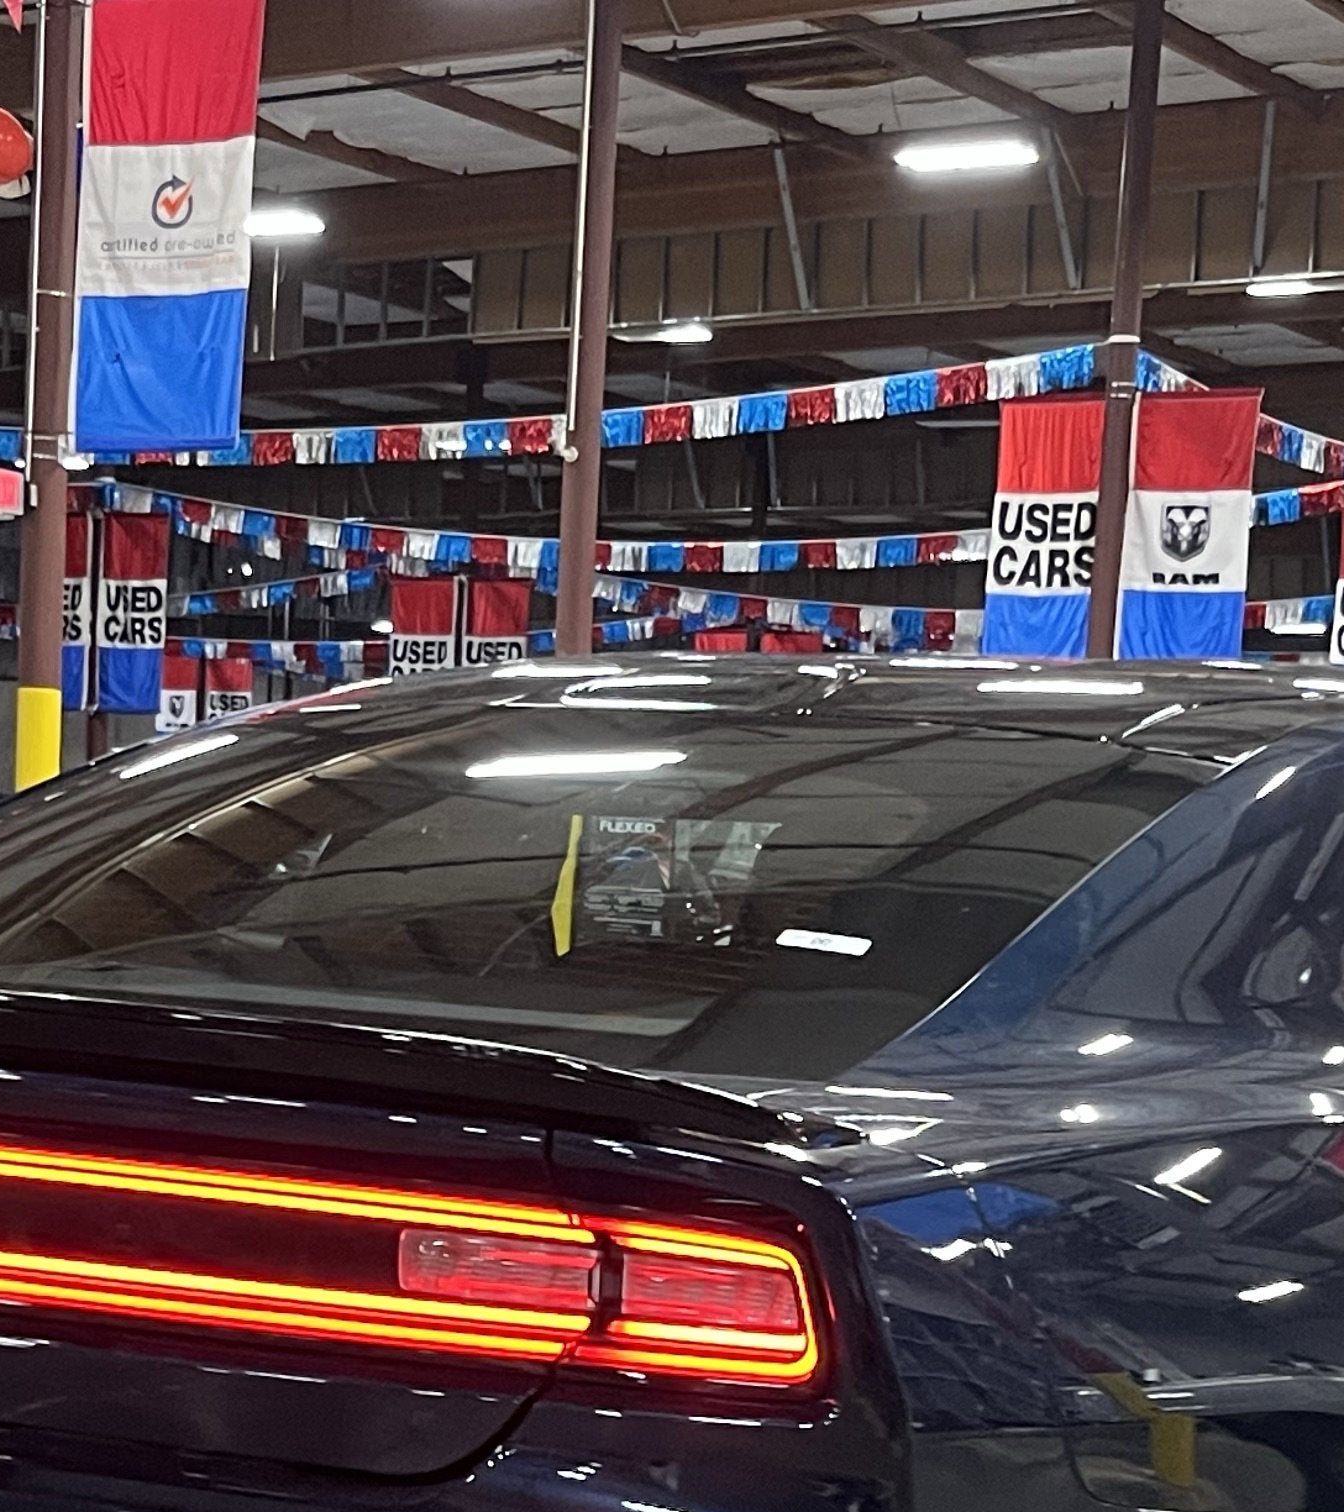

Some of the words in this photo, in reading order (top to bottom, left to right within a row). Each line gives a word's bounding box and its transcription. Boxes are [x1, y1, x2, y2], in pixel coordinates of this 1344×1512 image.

[164, 231, 236, 252] pre-owed
[998, 501, 1096, 543] USED
[993, 545, 1094, 588] CARS
[393, 639, 448, 664] USED
[466, 641, 523, 664] USED
